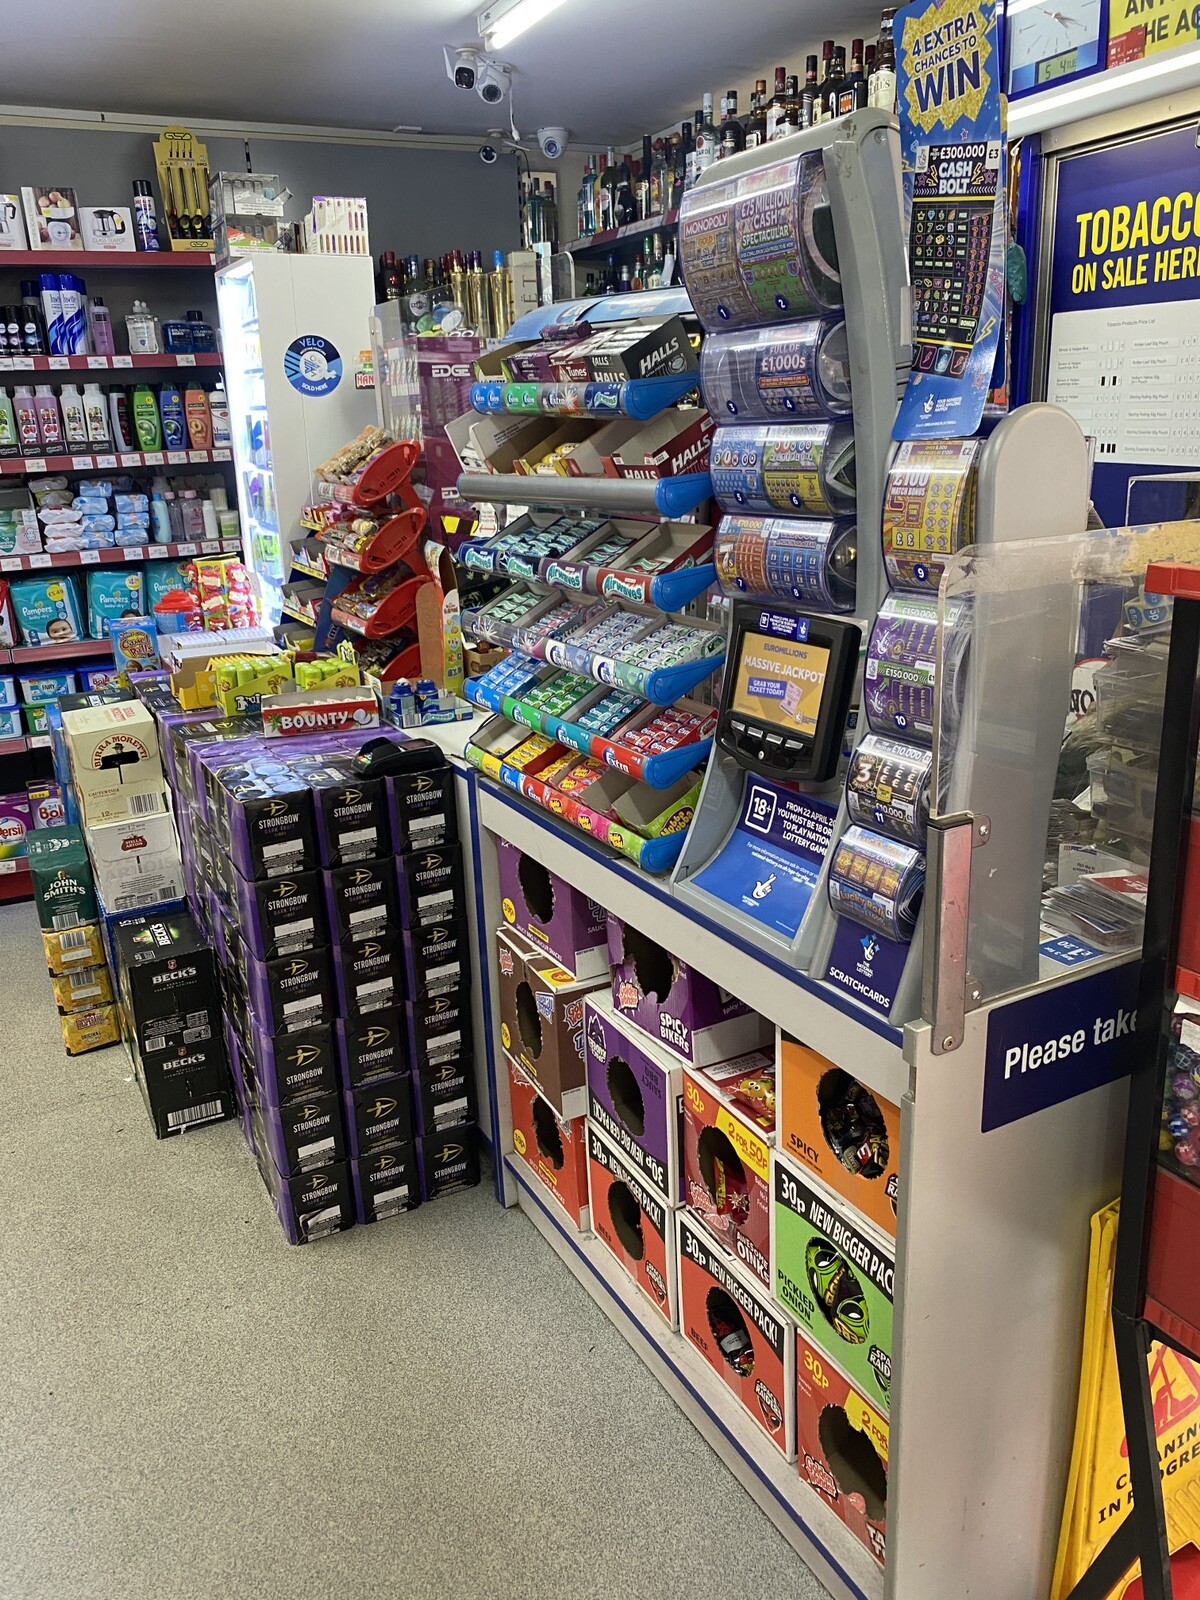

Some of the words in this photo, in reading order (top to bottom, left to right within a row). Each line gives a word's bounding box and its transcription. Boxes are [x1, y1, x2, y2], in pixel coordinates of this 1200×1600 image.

[912, 41, 922, 57] 4
[923, 12, 977, 52] EXTRA
[1131, 14, 1169, 43] HE
[914, 45, 960, 74] CHANCES
[962, 35, 977, 50] TO
[914, 51, 981, 113] WIN
[941, 145, 985, 159] £300,000
[989, 149, 999, 159] £3
[939, 161, 972, 178] CASH
[755, 190, 790, 214] MILLION
[684, 213, 728, 236] MONOPOLY
[753, 213, 779, 230] CASH
[742, 224, 790, 246] SPECTACULAR
[1071, 262, 1097, 294] ON
[1101, 253, 1149, 290] SALE
[1154, 245, 1200, 282] HER
[778, 299, 785, 309] 2
[299, 340, 325, 349] VELO
[770, 344, 789, 355] FULL
[789, 343, 800, 352] OF
[639, 336, 680, 375] HALLS
[432, 364, 470, 377] EDGE
[566, 367, 587, 376] Tunes
[302, 383, 315, 392] SOLD
[315, 383, 328, 391] HERE
[671, 433, 712, 474] HALLS
[891, 486, 908, 496] MATCH
[908, 487, 926, 496] BONUS
[546, 563, 582, 590] Airwaves
[917, 568, 924, 578] 9
[603, 575, 645, 604] Airwaves
[100, 594, 128, 604] Pampers
[22, 606, 52, 616] Pampers
[764, 643, 808, 659] EUROMILLIONS
[744, 655, 781, 673] MASSIVE
[781, 665, 824, 684] JACKPOT
[749, 685, 766, 694] TICKET
[766, 687, 785, 696] TODAY!
[765, 681, 780, 689] YOUR
[281, 710, 349, 730] BOUNTY
[513, 711, 532, 728] Extra
[895, 714, 906, 726] 10
[557, 730, 578, 750] Extra
[94, 740, 112, 768] BIRRA
[112, 735, 149, 760] MORETTI
[605, 754, 630, 774] Extra
[856, 762, 872, 783] 3
[406, 789, 444, 805] STRONGBOW
[754, 797, 771, 815] 18+
[333, 802, 373, 818] STRONGBOW
[786, 801, 804, 814] FROM
[803, 808, 810, 817] 22
[810, 811, 828, 825] APRIL
[875, 811, 884, 823] 11
[258, 813, 300, 830] STRONGBOW
[777, 807, 790, 818] YOU
[790, 812, 807, 826] MUST
[807, 819, 816, 829] BE
[816, 823, 823, 832] 18
[822, 826, 833, 836] OR
[783, 820, 792, 830] TO
[791, 824, 807, 836] PLAY
[783, 831, 810, 848] LOTTERY
[415, 866, 452, 882] STRONGBOW
[43, 886, 86, 901] SMITH'S
[49, 879, 78, 891] JOHN
[344, 881, 382, 898] STRONGBOW
[268, 894, 308, 911] STRONGBOW
[840, 891, 865, 904] Lucky
[422, 940, 458, 956] STRONGBOW
[354, 954, 392, 971] STRONGBOW
[152, 966, 197, 984] BECK'S
[829, 966, 890, 1008] SCRATCHCARDS
[424, 1009, 460, 1025] STRONGBOW
[660, 1012, 689, 1039] SPICY
[660, 1026, 690, 1053] BIKERS
[163, 1053, 206, 1071] BECK'S
[358, 1047, 394, 1064] STRONGBOW
[1003, 1029, 1086, 1080] Please
[286, 1066, 324, 1085] STRONGBOW
[431, 1076, 466, 1092] STRONGBOW
[293, 1115, 331, 1134] STRONGBOW
[365, 1118, 401, 1136] STRONGBOW
[728, 1122, 735, 1139] 2
[735, 1134, 748, 1151] FOR
[790, 1133, 820, 1163] SPICY
[369, 1165, 405, 1182] STRONGBOW
[434, 1162, 467, 1179] STRONGBOW
[591, 1135, 608, 1166] 30p
[642, 1192, 661, 1230] PACK!
[301, 1183, 339, 1202] STRONGBOW
[781, 1173, 806, 1214] 30p
[809, 1200, 834, 1234] NEW
[833, 1221, 870, 1272] BIGGER
[737, 1231, 768, 1270] AWESOME
[685, 1231, 707, 1267] 30p
[708, 1255, 726, 1283] NEW
[726, 1274, 754, 1317] BIGGER
[754, 1305, 778, 1348] PACK!
[778, 1268, 815, 1312] PICKLED
[782, 1287, 812, 1321] ONION
[691, 1327, 709, 1351] BEEF
[861, 1410, 871, 1430] 2
[1098, 1498, 1121, 1524] IN
